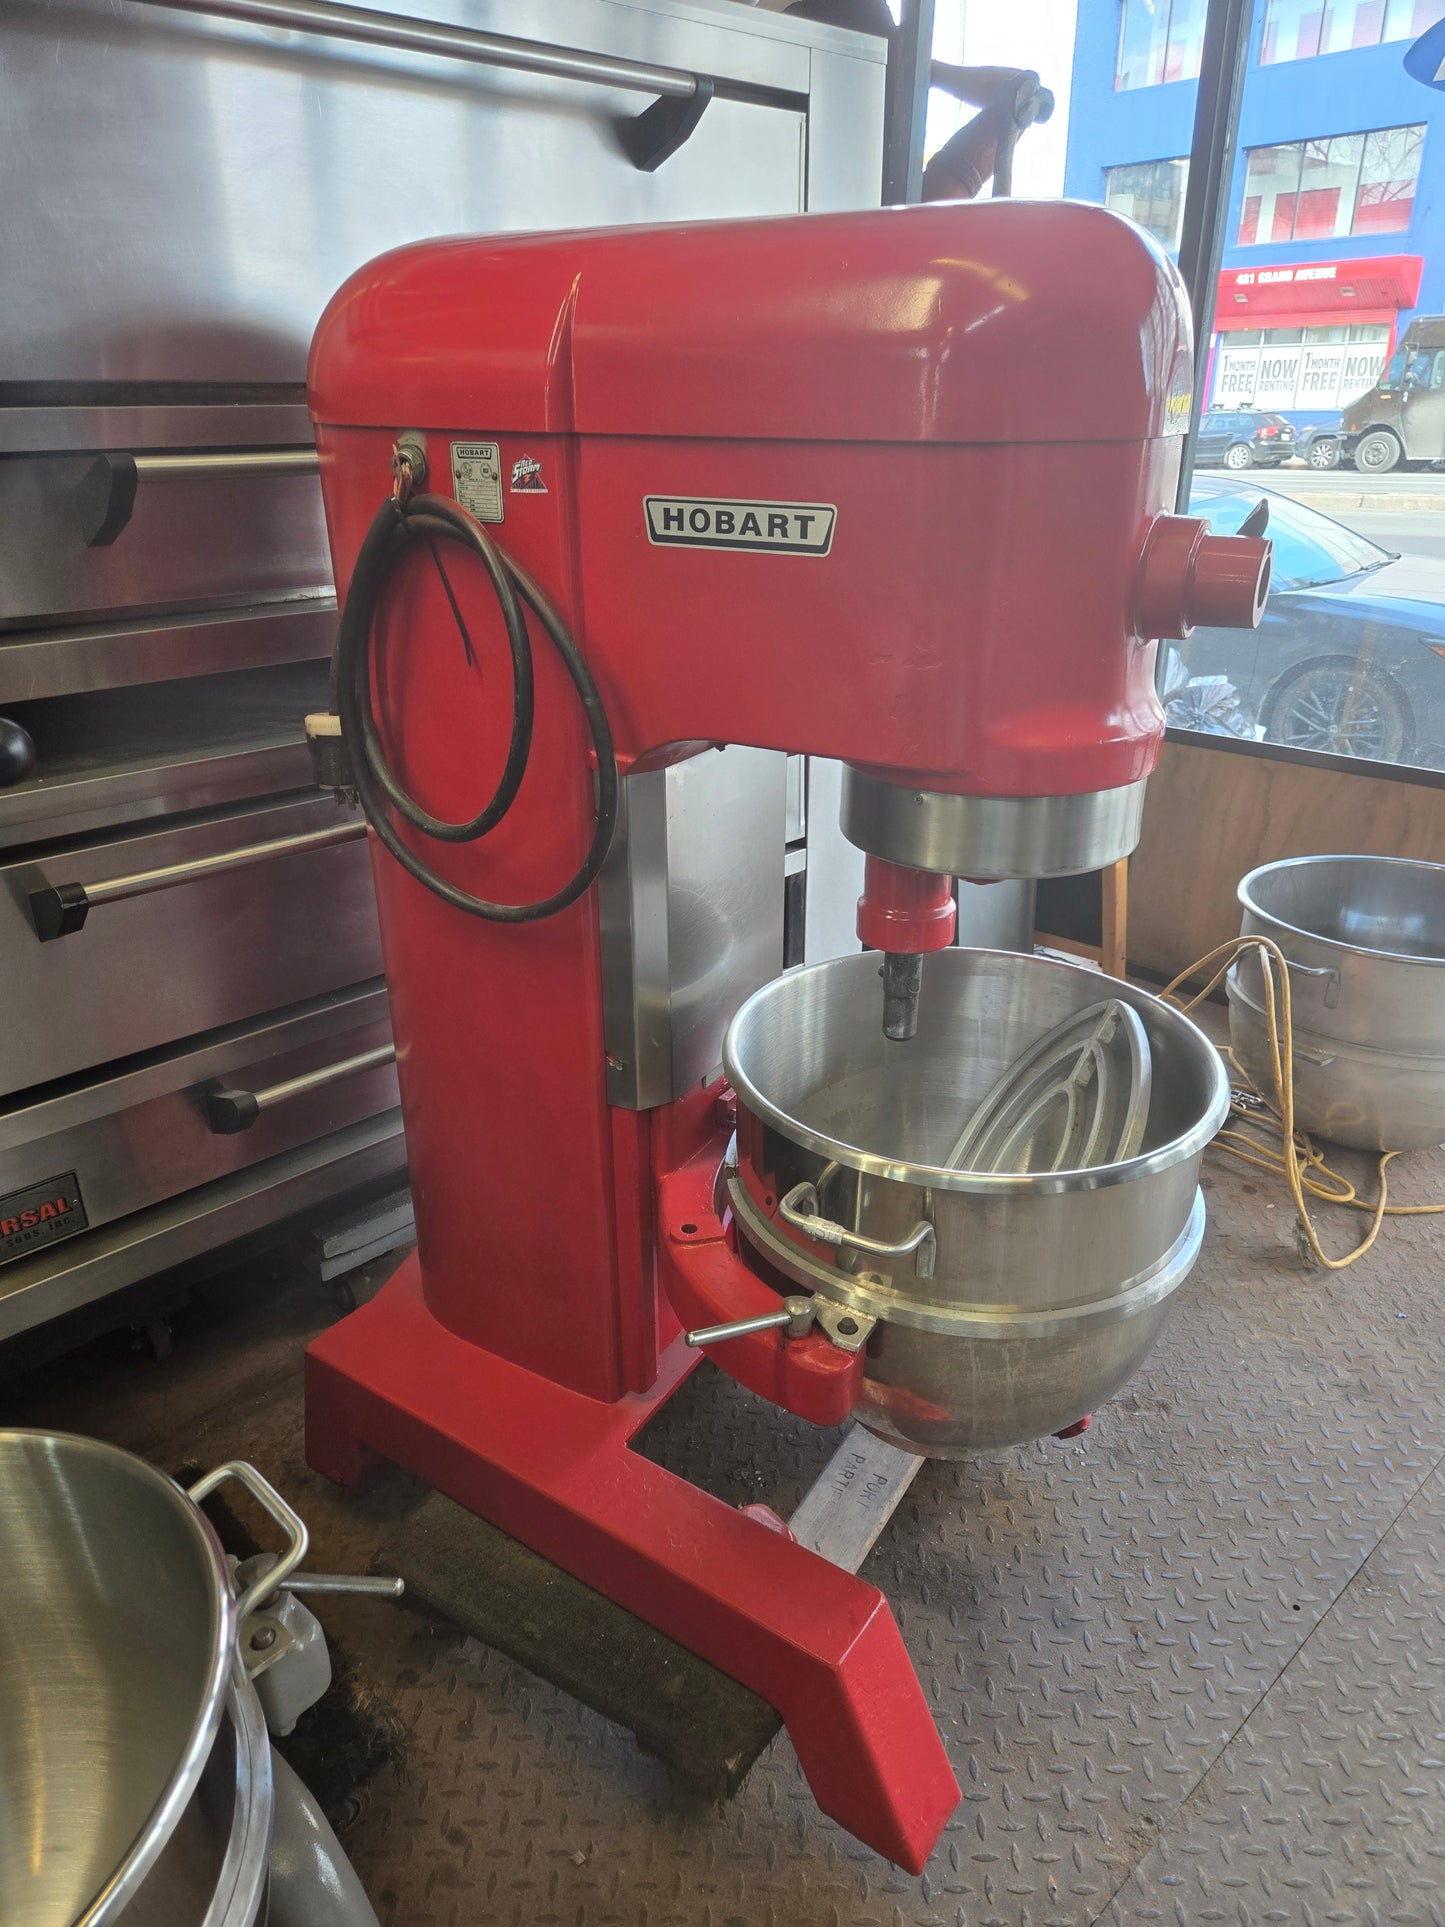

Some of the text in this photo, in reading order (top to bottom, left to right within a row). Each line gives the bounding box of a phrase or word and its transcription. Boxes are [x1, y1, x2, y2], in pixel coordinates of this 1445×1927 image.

[1230, 361, 1256, 371] MONTH
[1261, 359, 1298, 379] NOW
[1311, 358, 1341, 369] MONTH
[1221, 374, 1253, 392] FREE
[1258, 380, 1295, 392] RENTING
[1302, 371, 1338, 391] FREE
[1343, 378, 1376, 389] RENTIN
[663, 507, 815, 540] HOBART
[0, 1198, 72, 1238] RSAL
